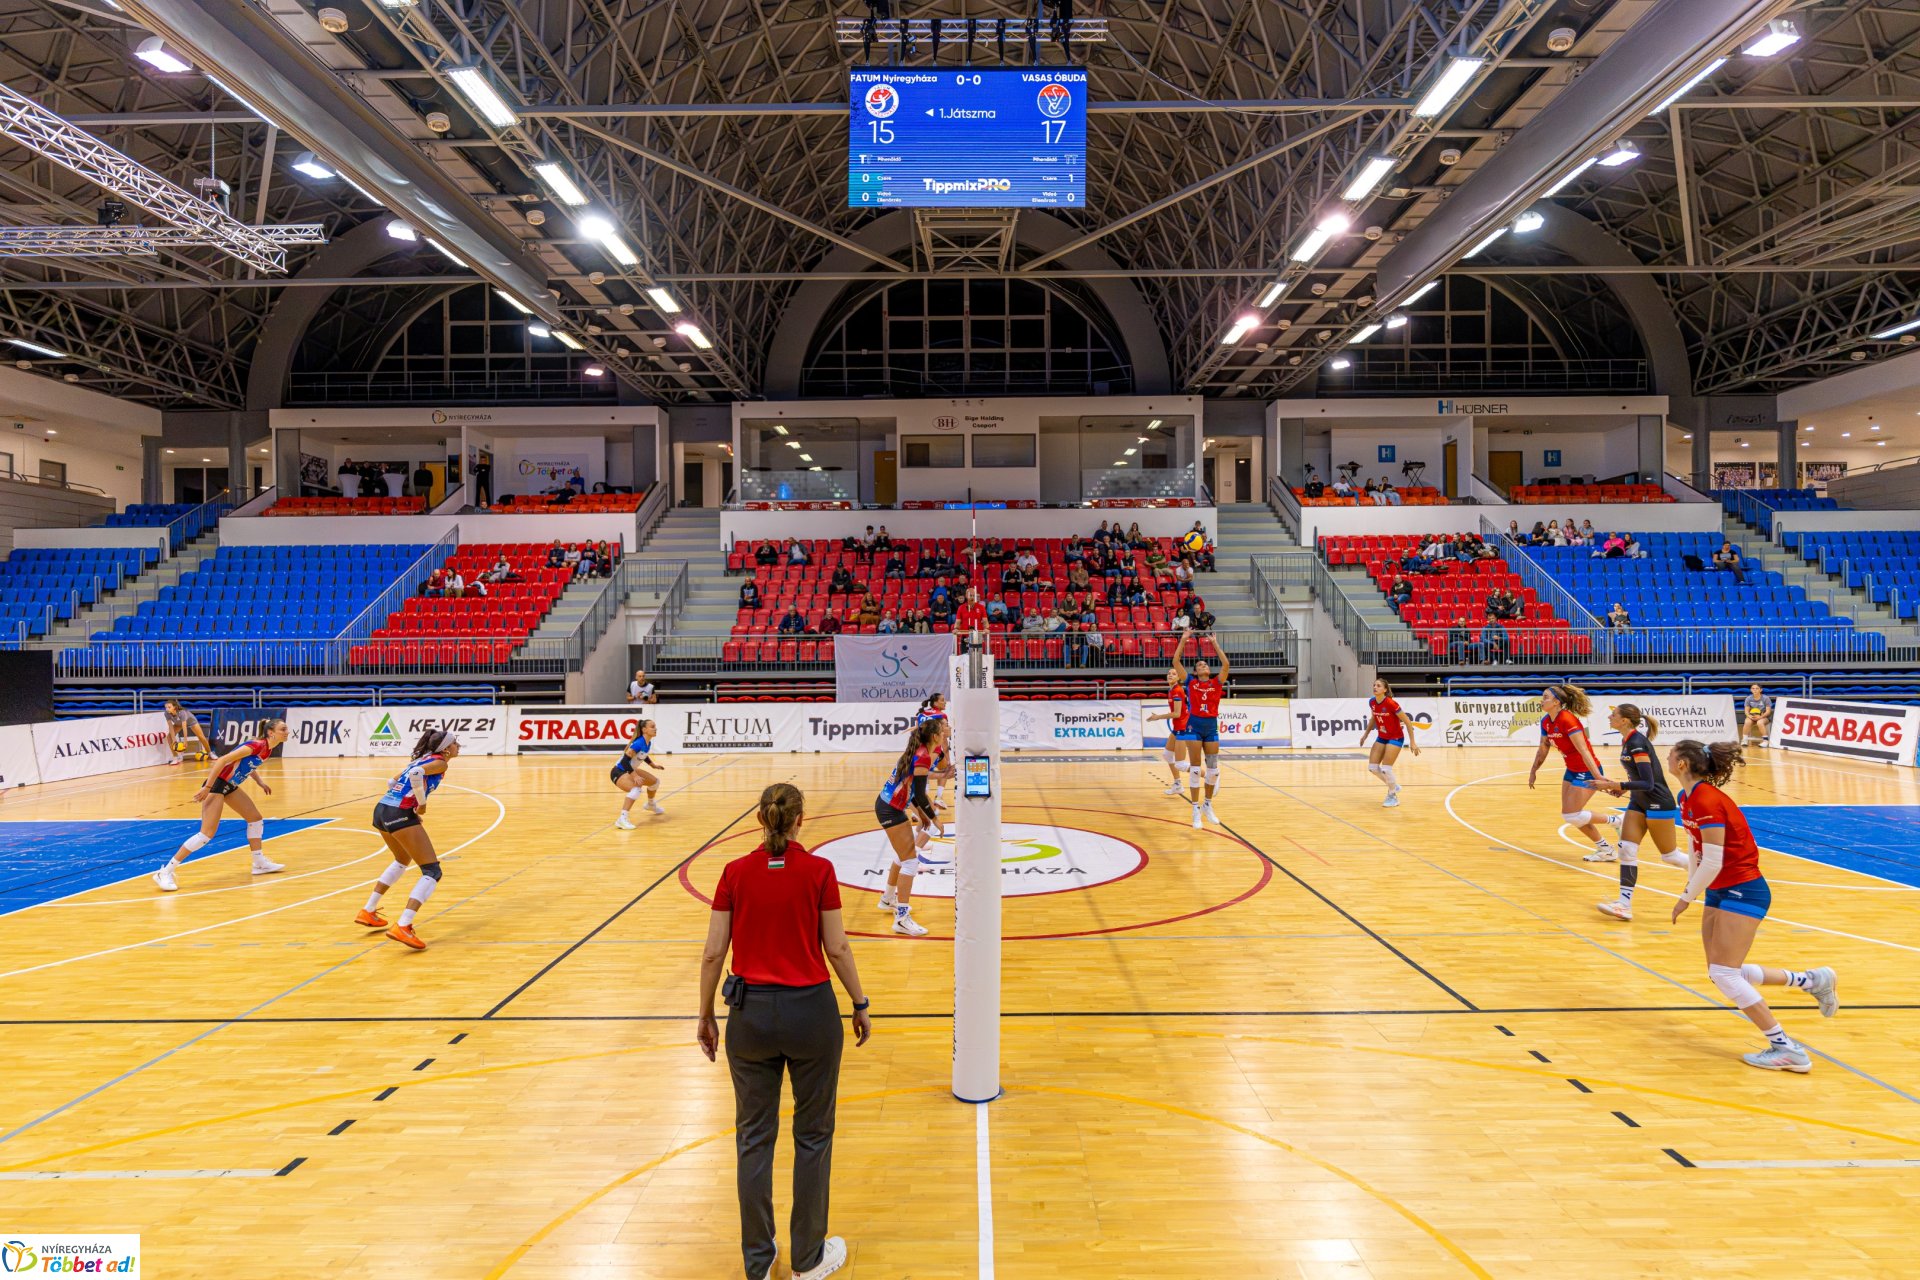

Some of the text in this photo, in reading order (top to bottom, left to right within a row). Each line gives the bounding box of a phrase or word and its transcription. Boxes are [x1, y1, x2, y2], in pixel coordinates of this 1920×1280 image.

[851, 74, 880, 82] FATUM
[1022, 72, 1087, 82] VASAS ÓBUDA
[868, 120, 895, 144] 15
[1041, 120, 1067, 144] 17
[862, 173, 870, 182] 0
[1069, 173, 1074, 183] 1
[923, 178, 1011, 194] TippmixPRO
[862, 192, 869, 202] 0
[1067, 193, 1075, 202] 0
[1456, 404, 1508, 414] HÜBNER
[938, 419, 954, 427] BH
[861, 686, 928, 699] RÖPLABDA
[1455, 701, 1542, 715] Környezettuda
[683, 710, 772, 735] FATUM
[1054, 712, 1125, 724] TippmixPRO
[1477, 716, 1533, 730] nyíregyházi
[1640, 719, 1725, 728] SRTCENTRUM
[408, 718, 496, 732] KE-VIZ 21
[518, 719, 639, 741] STRABAG
[809, 717, 919, 741] TippmixP
[1218, 720, 1266, 733] bet ad!
[1782, 712, 1903, 748] STRABAG
[1054, 727, 1125, 738] EXTRALIGA
[54, 731, 167, 759] ALANEX.SHOP
[863, 866, 1088, 876] NREHÁZA
